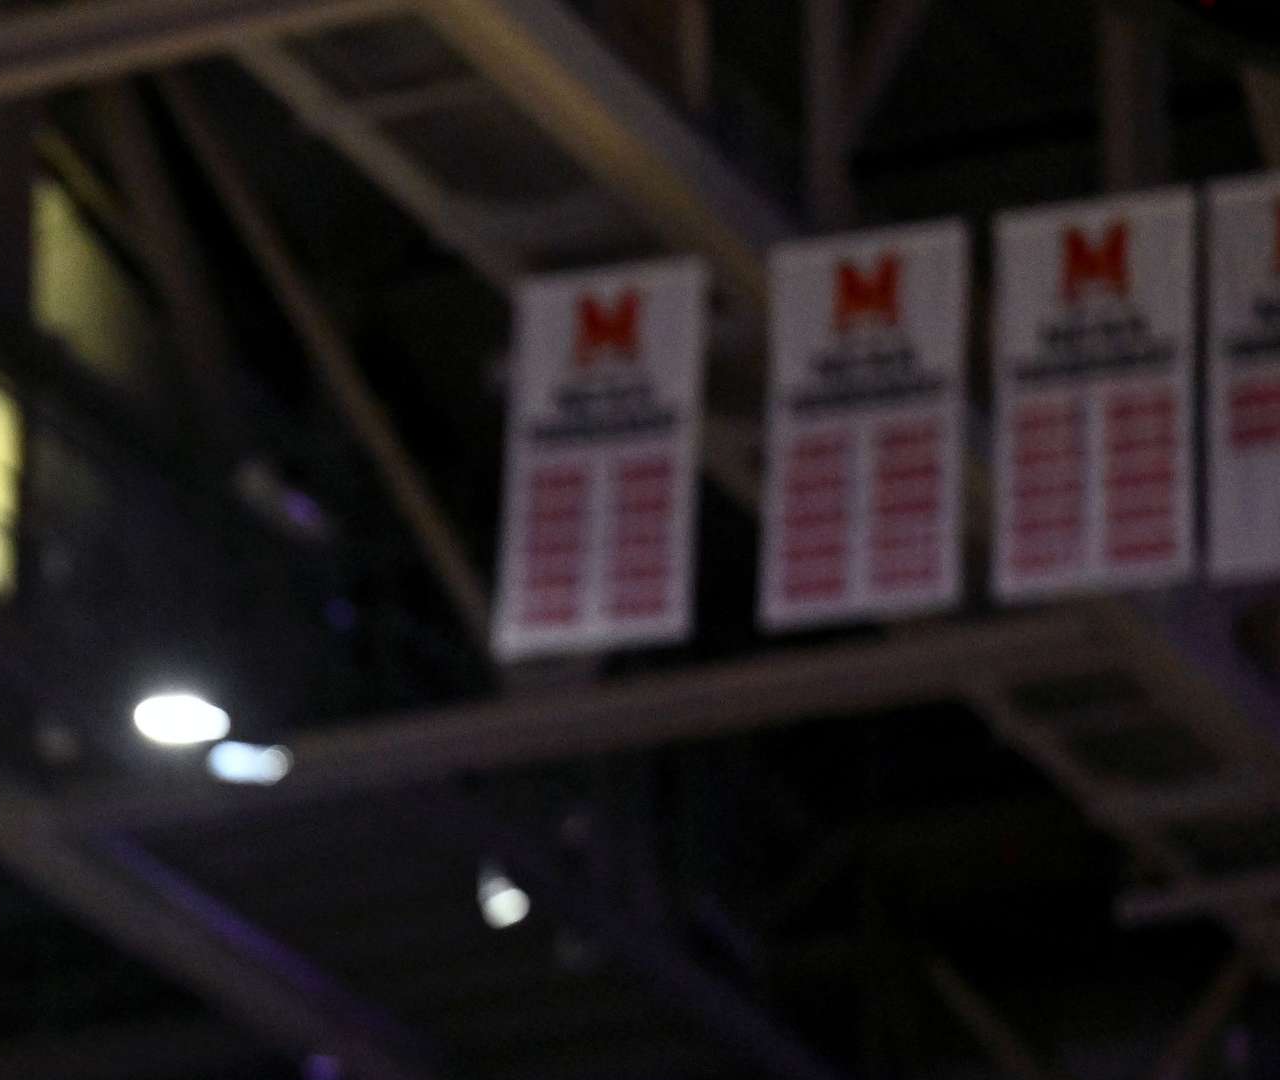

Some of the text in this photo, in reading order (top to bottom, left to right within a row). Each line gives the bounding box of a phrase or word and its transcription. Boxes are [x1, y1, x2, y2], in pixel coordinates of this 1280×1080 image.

[834, 252, 902, 332] M
[1062, 218, 1130, 302] M
[574, 288, 642, 368] M
